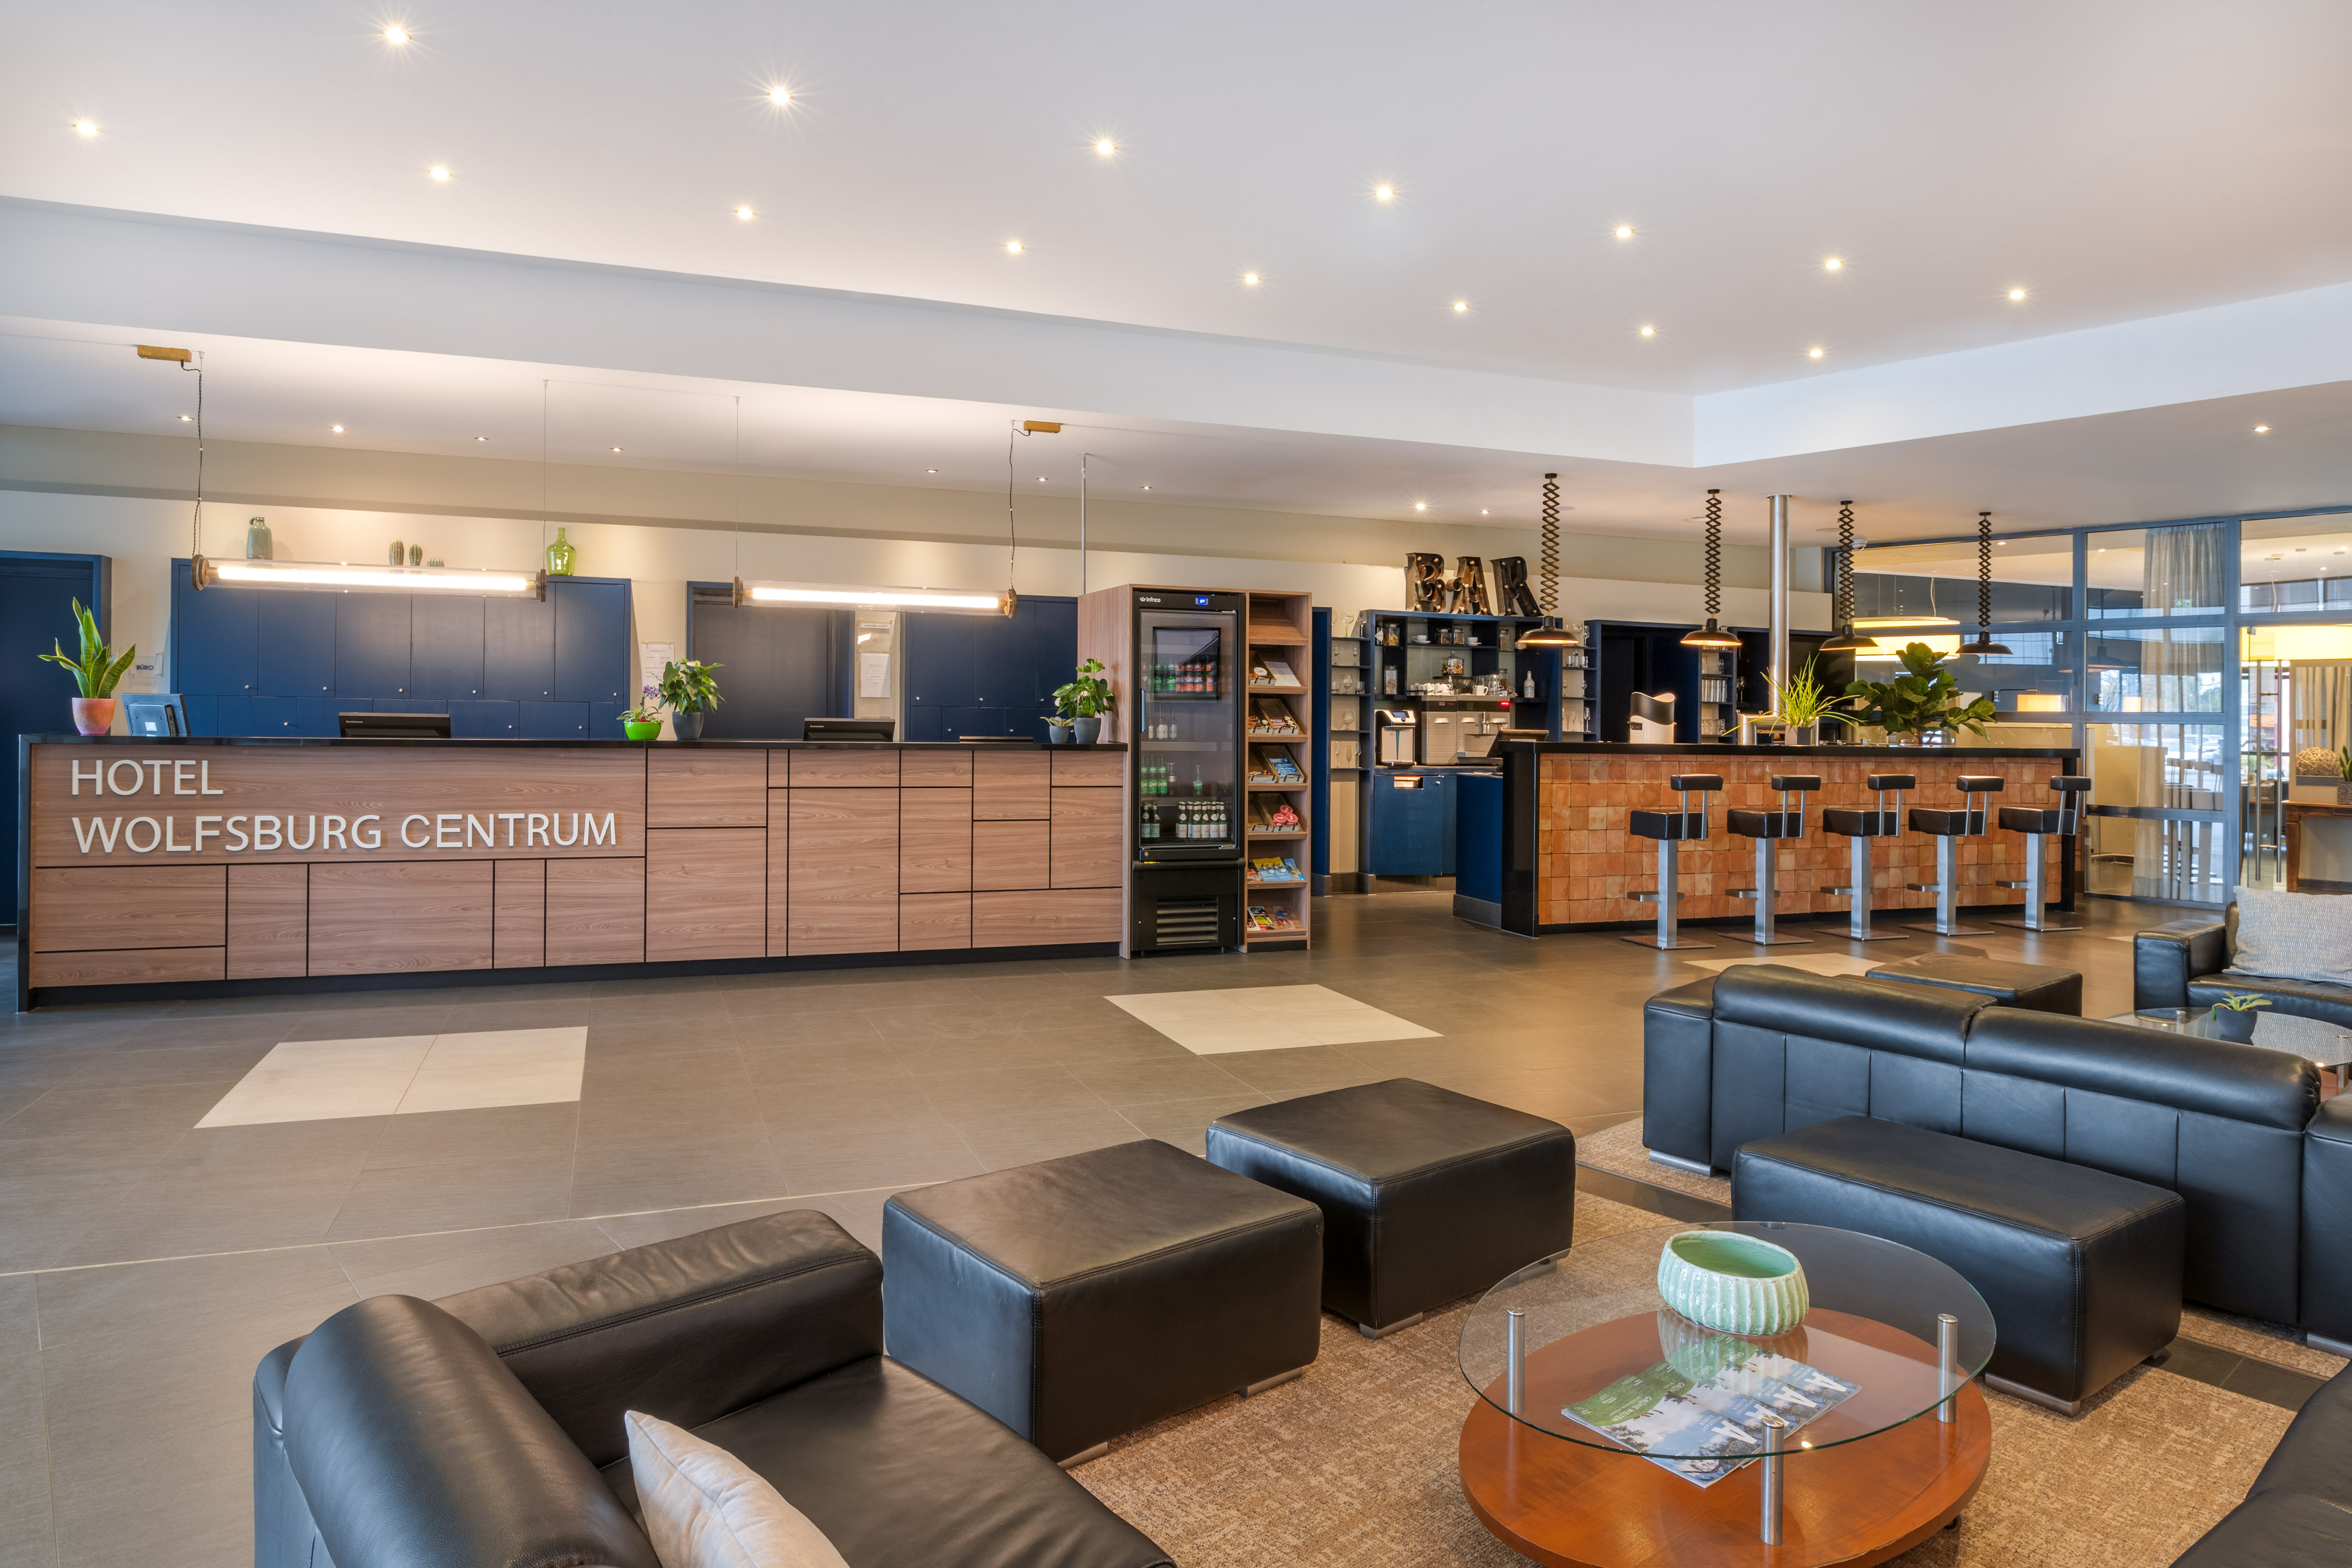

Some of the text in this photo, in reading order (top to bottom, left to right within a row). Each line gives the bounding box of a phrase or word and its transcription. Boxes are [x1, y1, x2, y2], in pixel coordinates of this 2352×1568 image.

[1405, 552, 1544, 616] BAR
[72, 759, 223, 795] HOTEL
[72, 813, 616, 853] WOLFSBURG CENTRUM
[1632, 1396, 1652, 1410] GRÜNE
[1773, 1386, 1817, 1408] A
[1611, 1408, 1634, 1422] WELTEN
[1711, 1420, 1757, 1444] A
